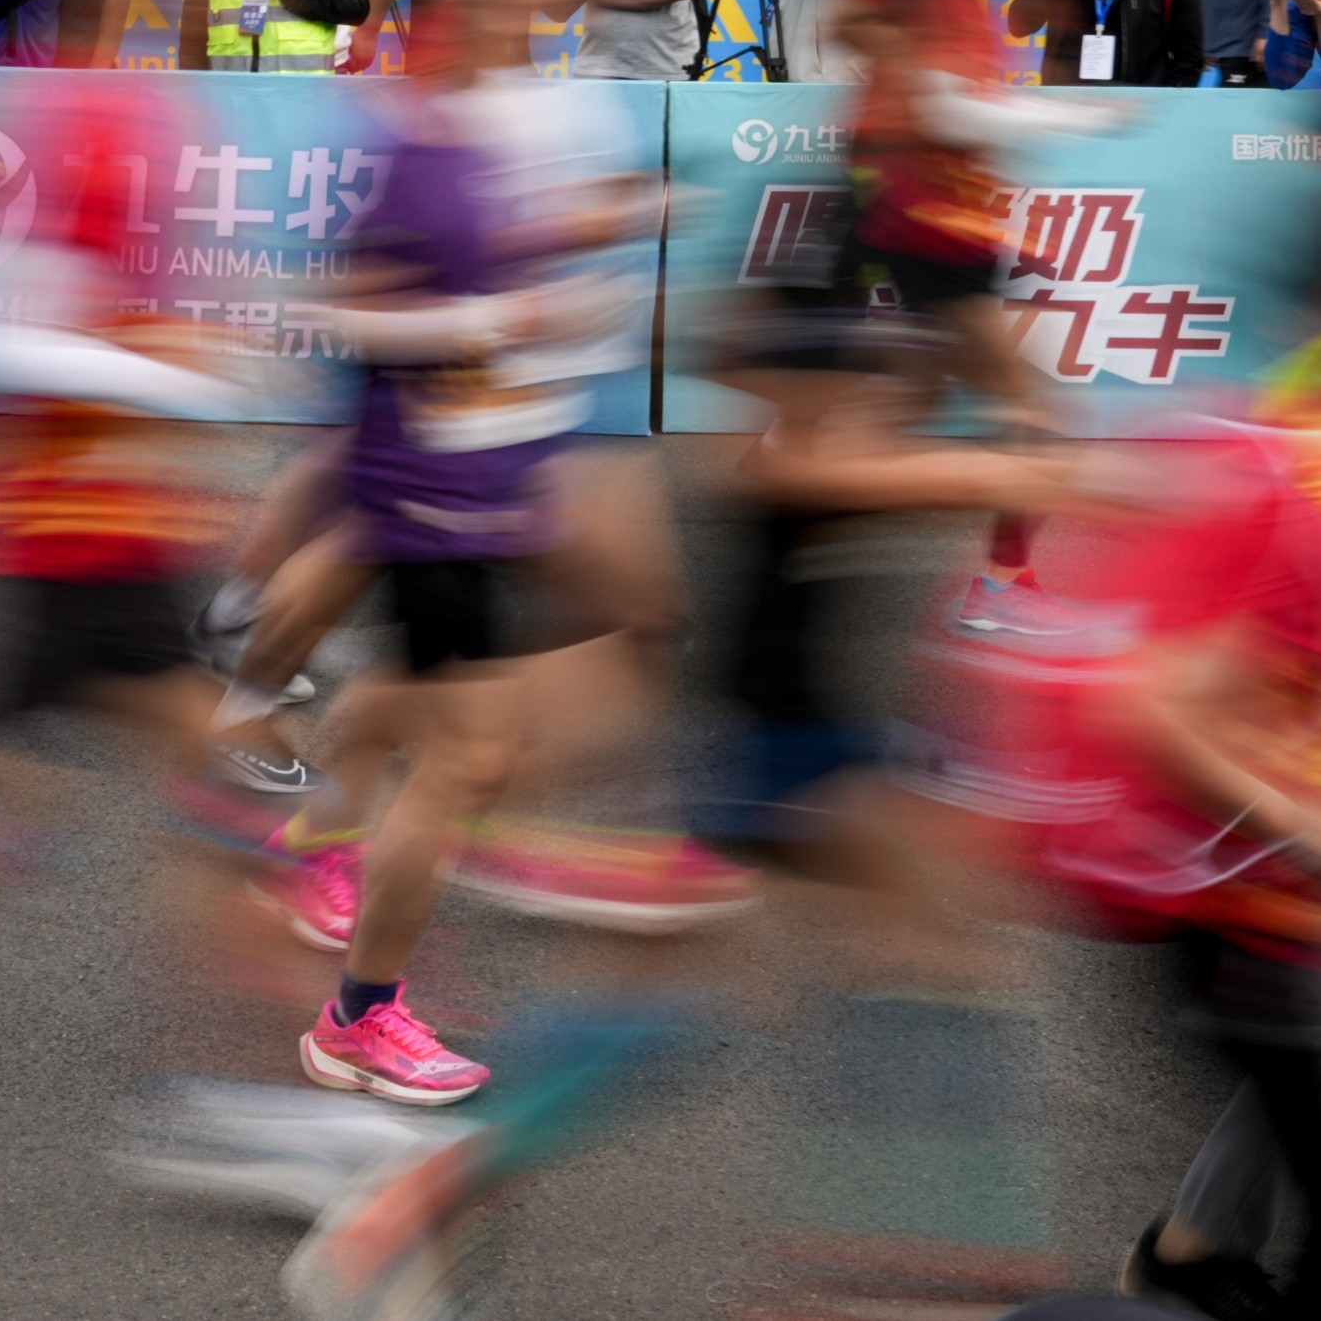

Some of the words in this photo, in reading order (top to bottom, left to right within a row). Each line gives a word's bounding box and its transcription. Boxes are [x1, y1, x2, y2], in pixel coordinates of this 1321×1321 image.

[63, 143, 395, 242] 九牛牧
[168, 248, 294, 279] ANIMAL
